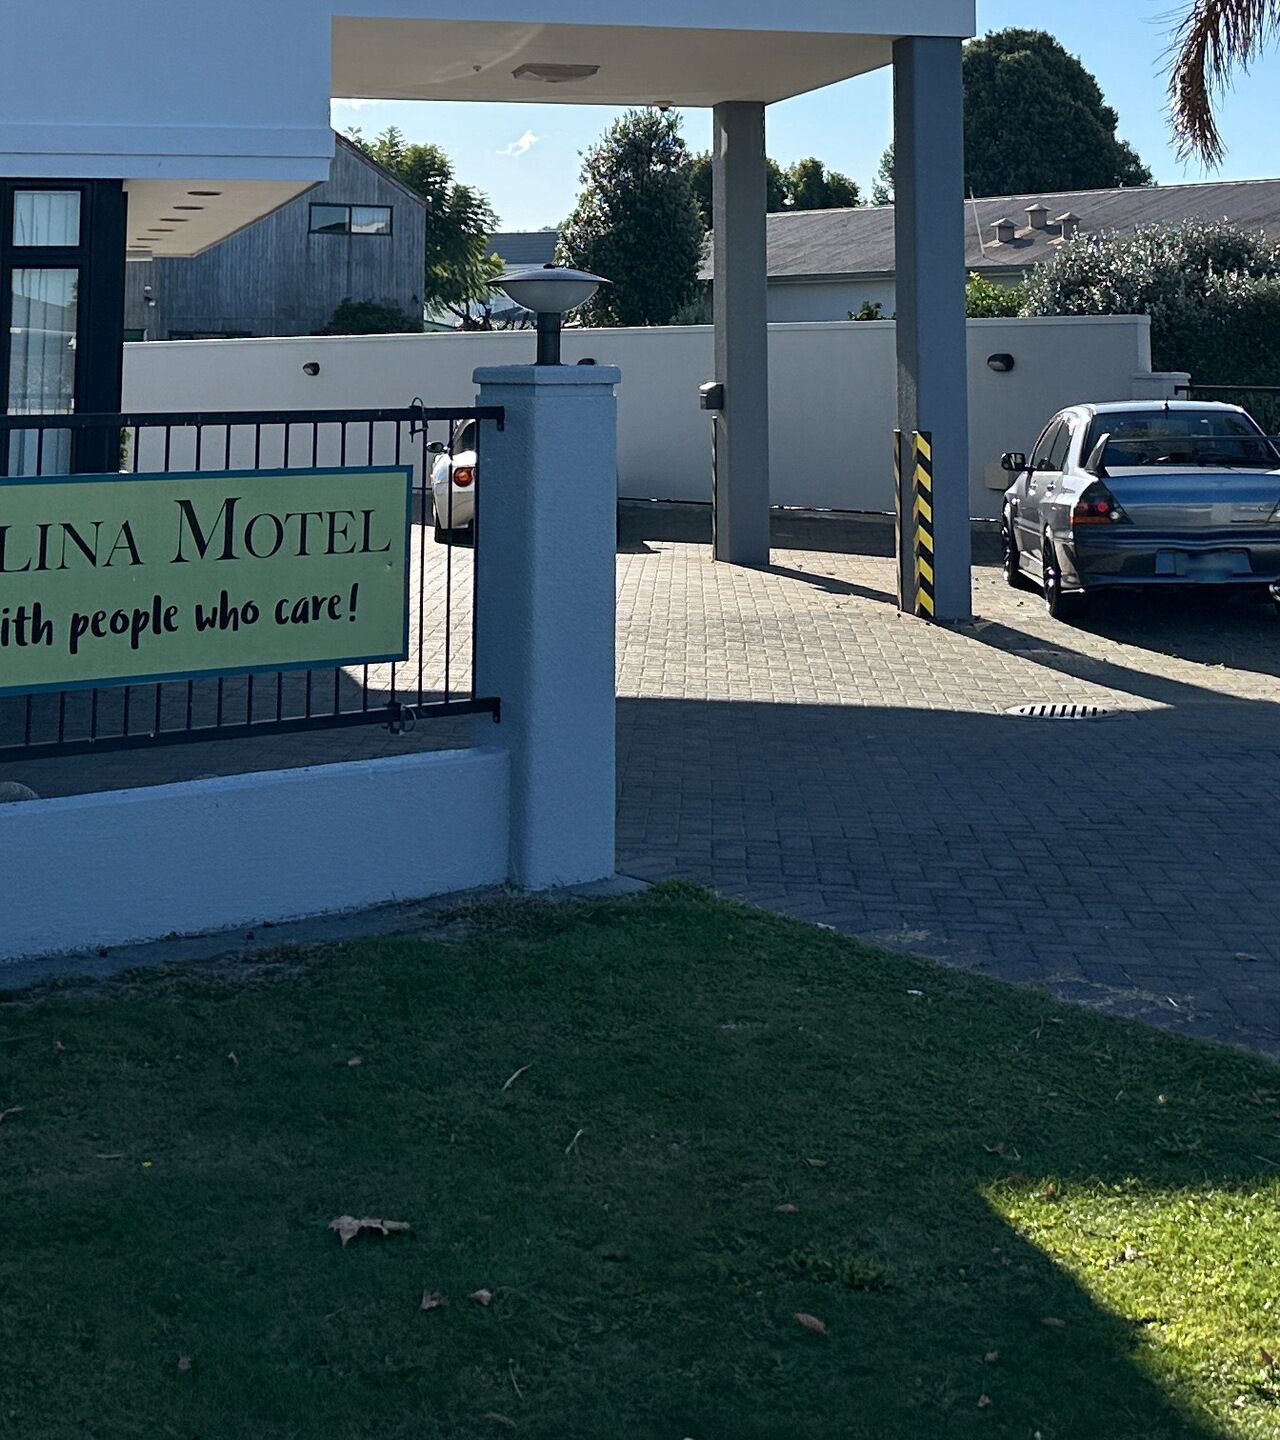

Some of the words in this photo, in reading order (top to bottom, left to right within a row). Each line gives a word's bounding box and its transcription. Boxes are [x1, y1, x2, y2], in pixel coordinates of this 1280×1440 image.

[169, 497, 392, 563] MOTEL
[70, 595, 179, 655] people
[195, 589, 260, 632] who
[274, 582, 360, 625] care!
